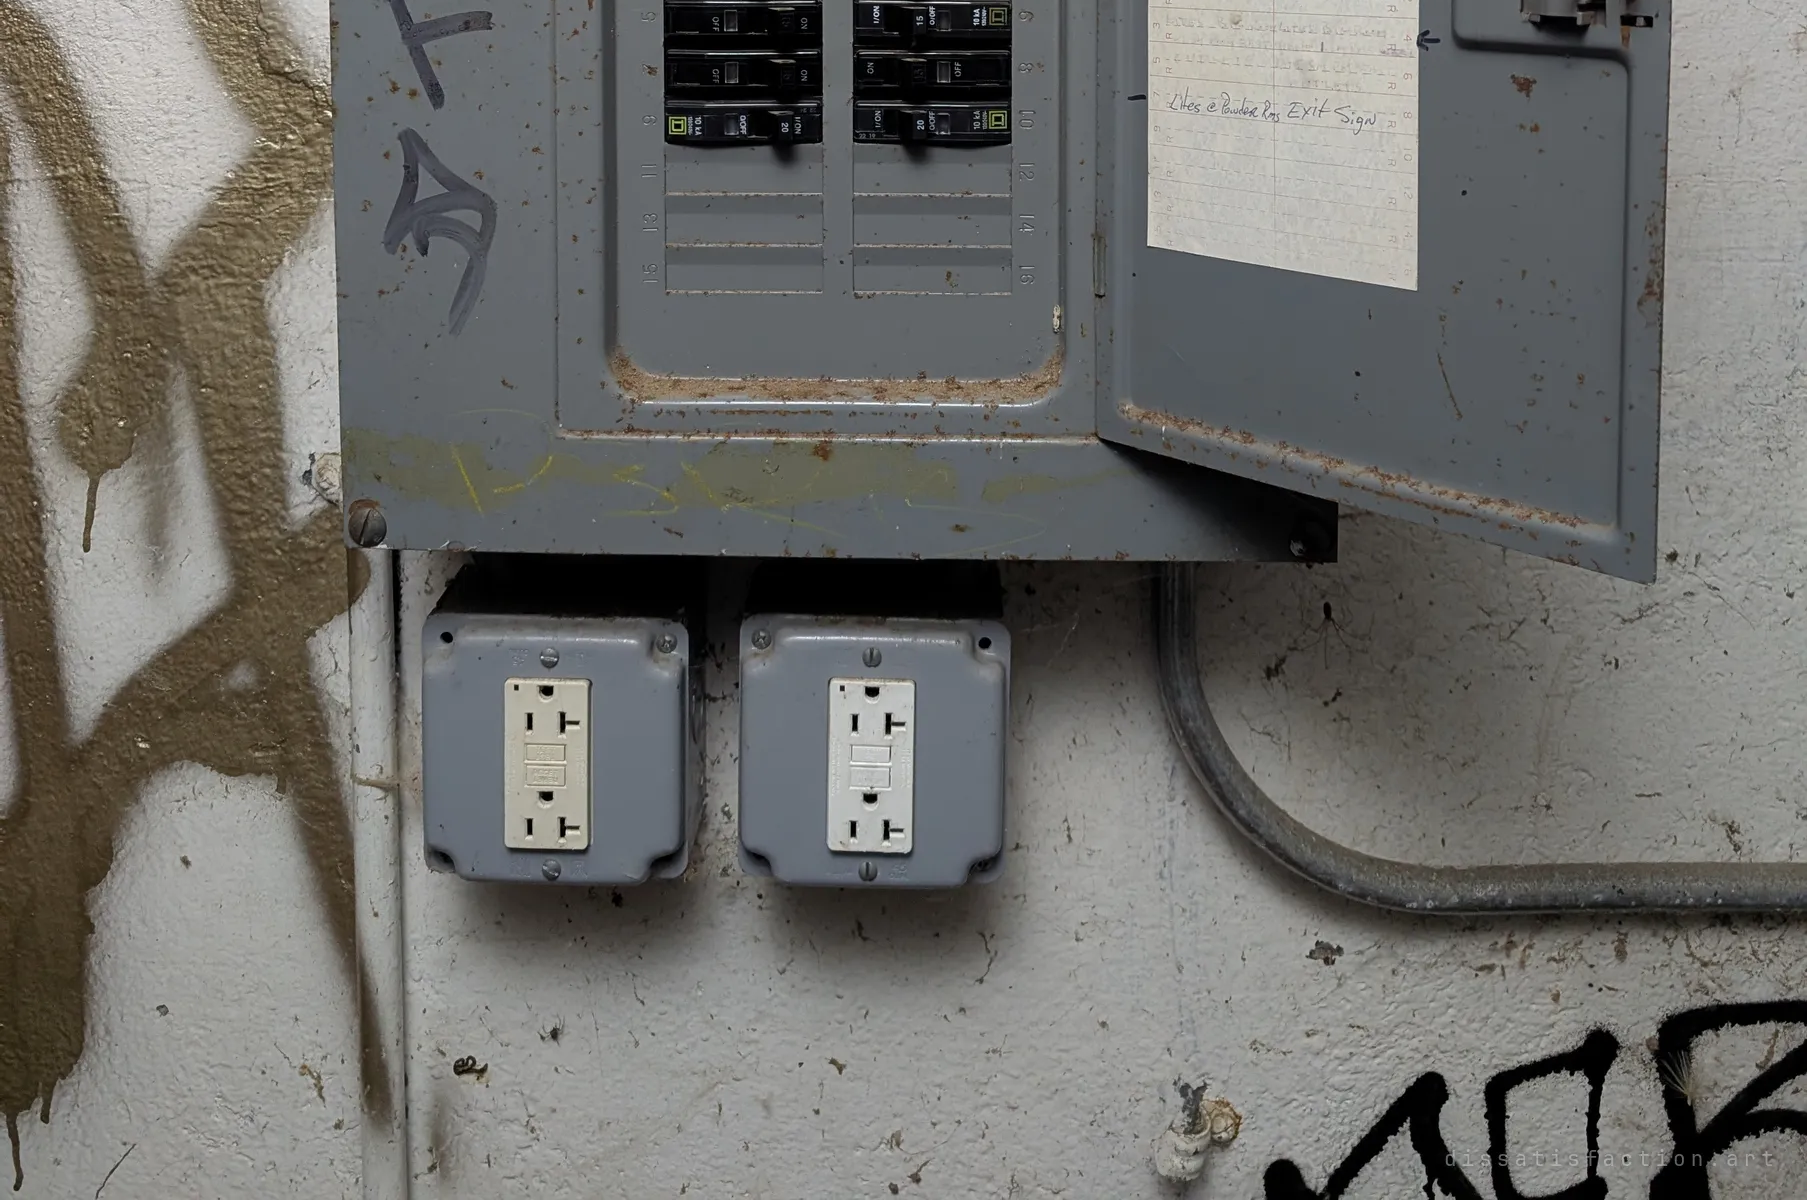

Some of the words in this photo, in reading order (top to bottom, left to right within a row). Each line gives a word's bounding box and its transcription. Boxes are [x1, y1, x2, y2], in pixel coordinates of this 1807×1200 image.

[800, 17, 808, 30] ON
[916, 16, 924, 27] 15
[973, 17, 980, 27] 10
[867, 62, 874, 75] ON
[954, 62, 962, 78] OFF
[800, 69, 808, 82] ON
[1286, 98, 1331, 119] Exit
[973, 110, 981, 120] kA
[781, 122, 788, 133] 20
[916, 120, 924, 131] 20
[973, 120, 981, 130] 10
